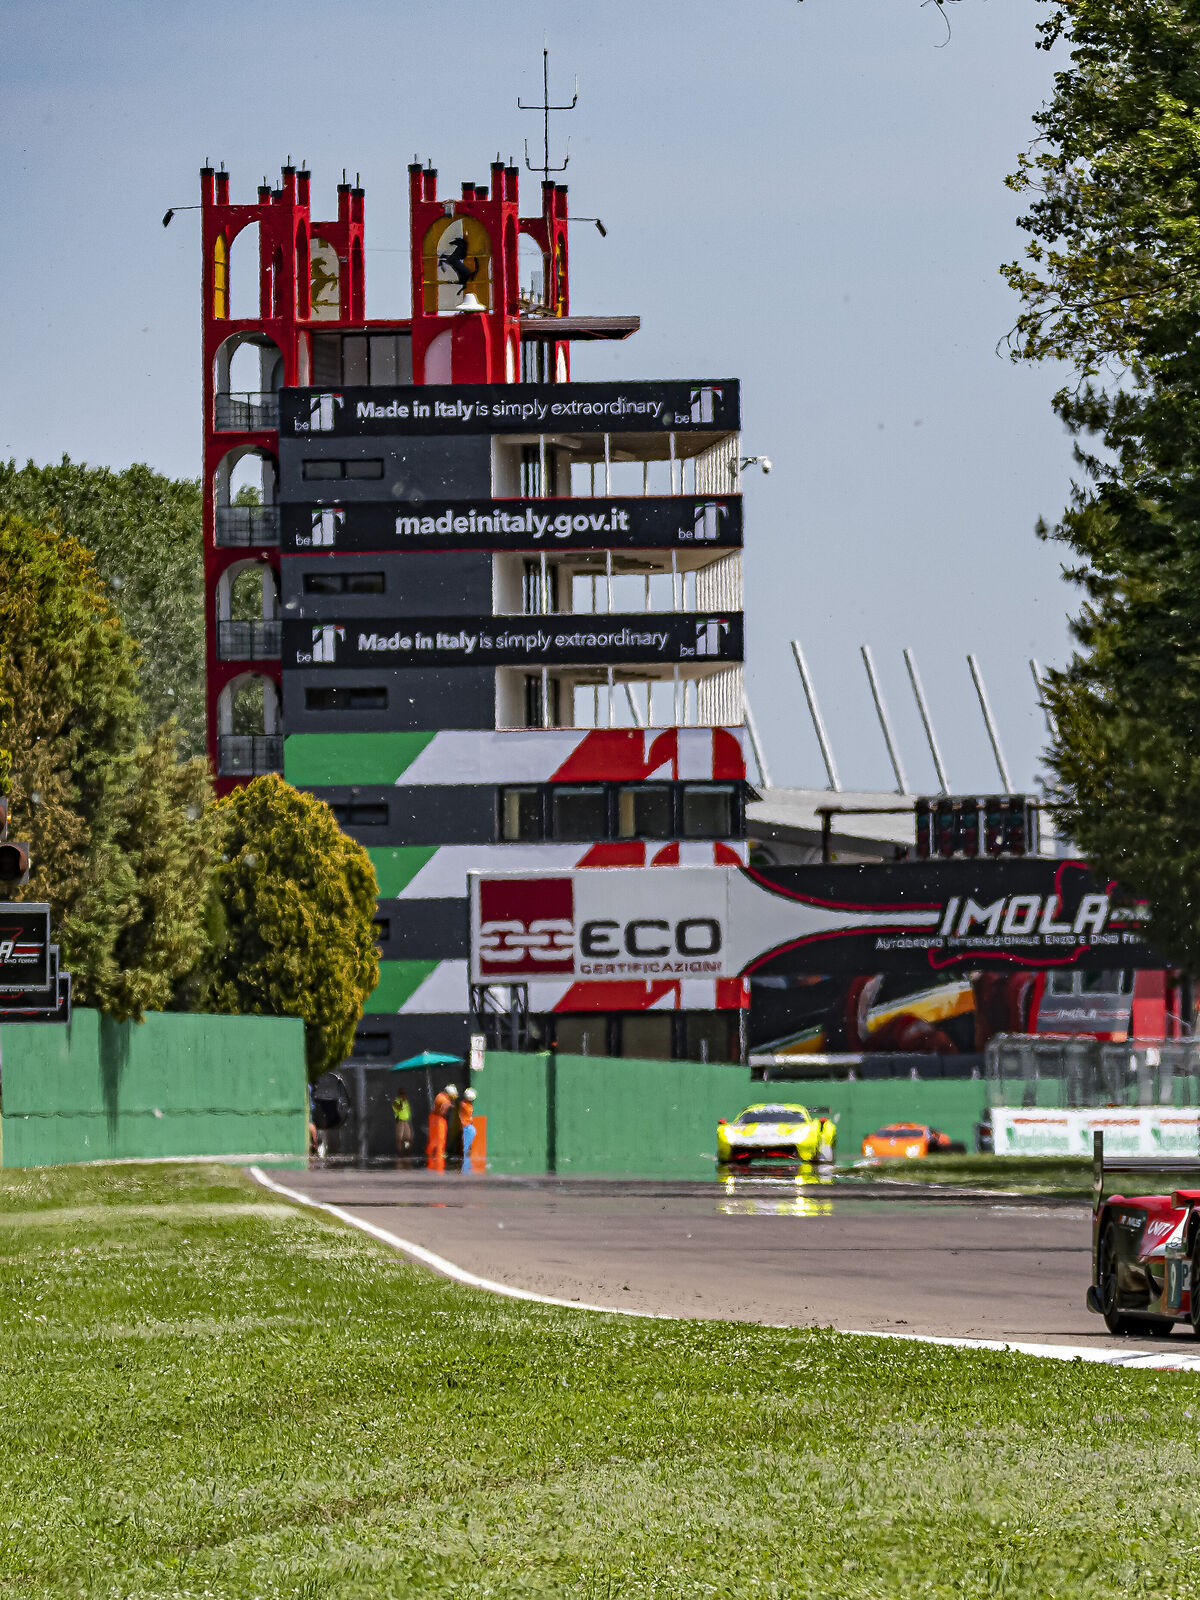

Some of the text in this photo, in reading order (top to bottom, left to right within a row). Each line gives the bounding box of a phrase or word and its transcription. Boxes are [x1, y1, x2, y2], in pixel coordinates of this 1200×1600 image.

[356, 397, 662, 421] Made in Italy is simply extraordinary
[294, 417, 309, 431] be
[674, 412, 690, 425] be
[395, 508, 629, 538] madeinitaly.gov.it
[296, 534, 310, 547] be
[678, 527, 694, 540] be
[358, 629, 668, 653] Made in Italy is simply extraordinary
[296, 650, 311, 663] be
[680, 643, 695, 656] be
[939, 893, 1111, 935] IMOLA
[579, 917, 722, 958] ECO
[580, 960, 722, 975] CERTIFICAZIONI
